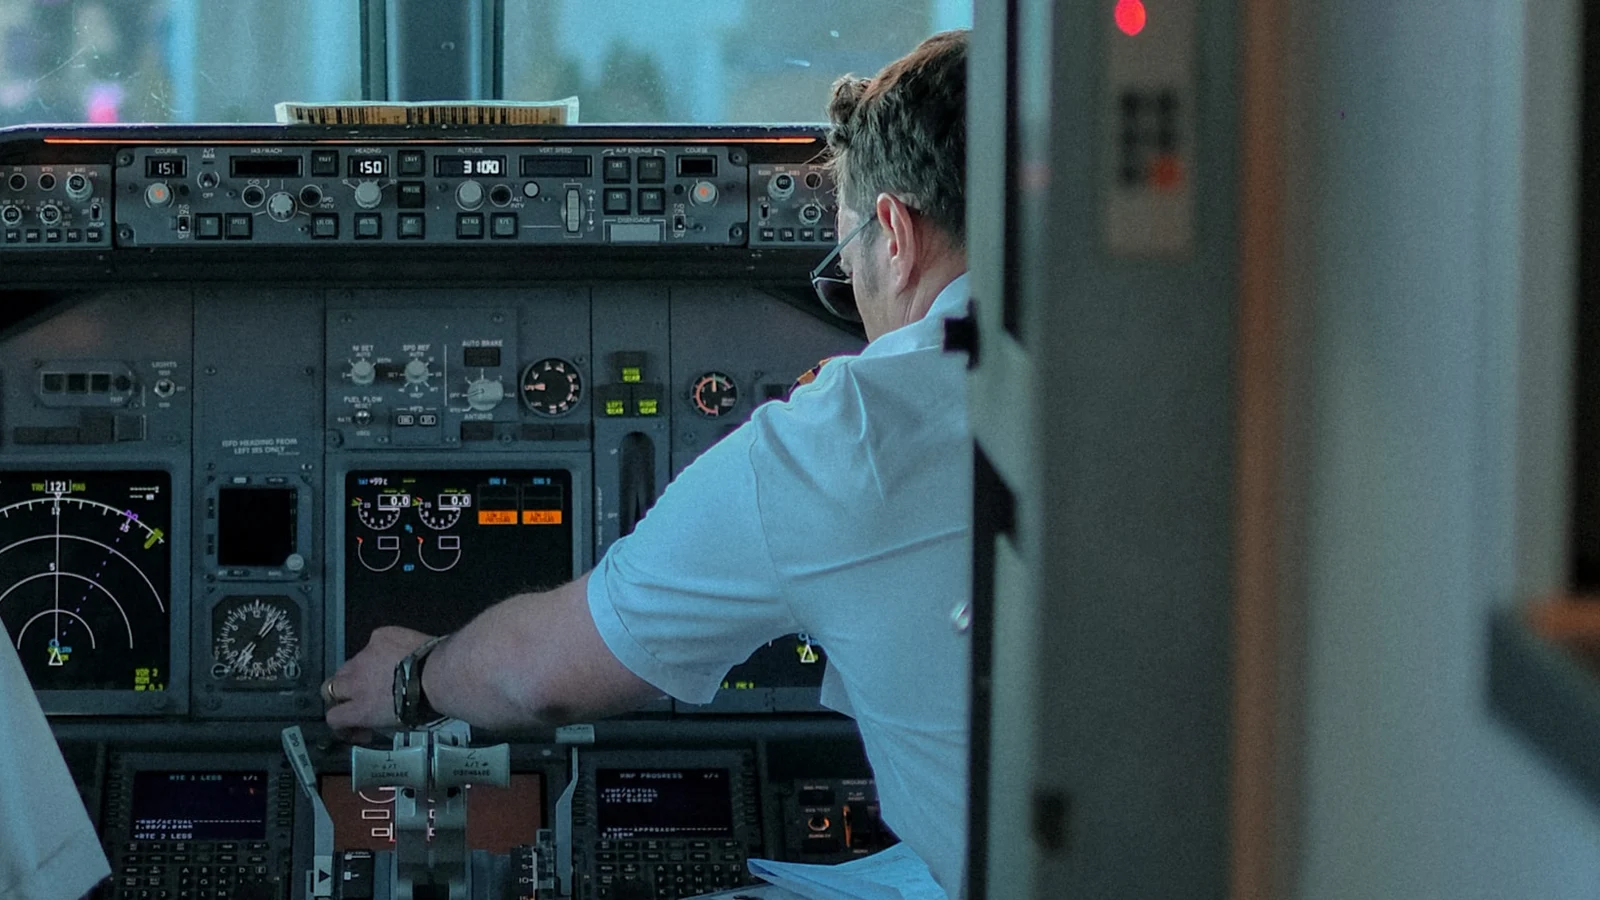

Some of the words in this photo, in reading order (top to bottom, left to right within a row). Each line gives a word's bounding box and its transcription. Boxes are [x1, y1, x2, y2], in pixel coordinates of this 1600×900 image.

[158, 162, 176, 175] 151
[359, 160, 382, 174] 150
[50, 481, 67, 492] 121
[390, 496, 409, 506] 0.0
[451, 496, 470, 506] 0.0
[49, 562, 55, 571] 5
[152, 668, 158, 677] 2
[519, 876, 529, 884] 10
